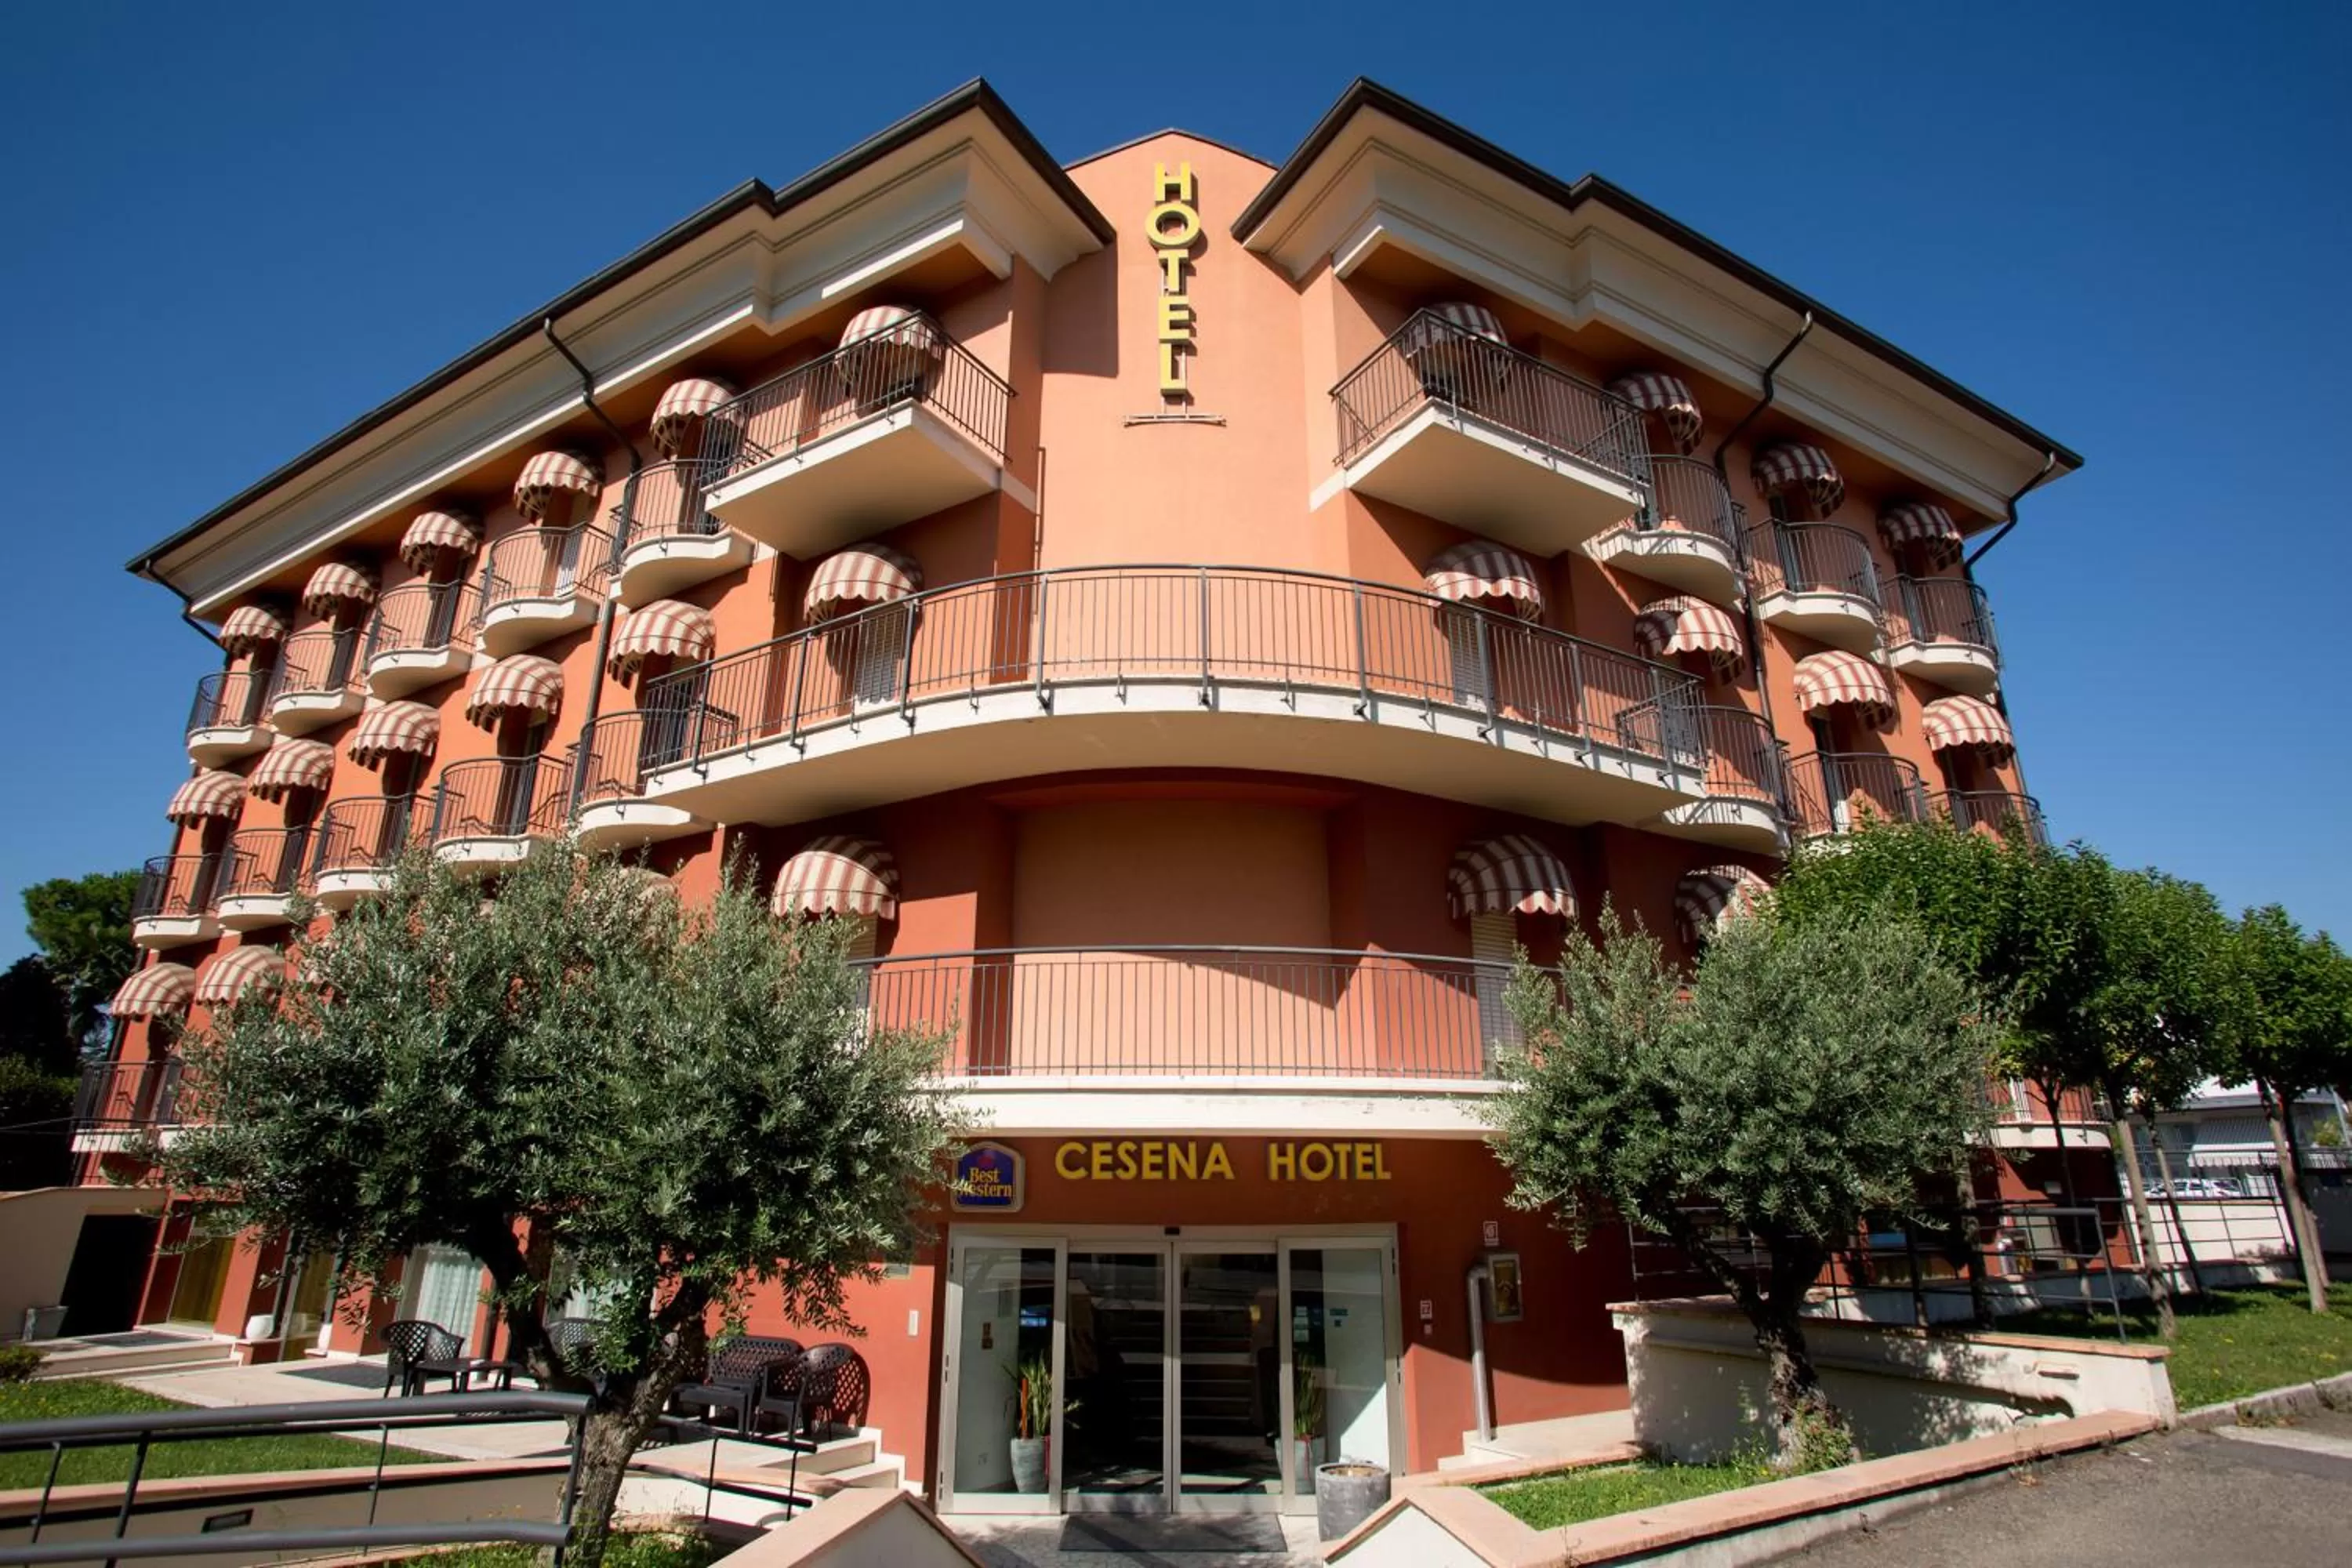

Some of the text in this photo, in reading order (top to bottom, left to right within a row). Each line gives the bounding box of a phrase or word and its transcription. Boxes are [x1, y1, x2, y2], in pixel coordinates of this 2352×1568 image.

[1145, 162, 1200, 395] HOTEL
[970, 1167, 1000, 1182] Best
[1055, 1142, 1392, 1181] CESENA HOTEL
